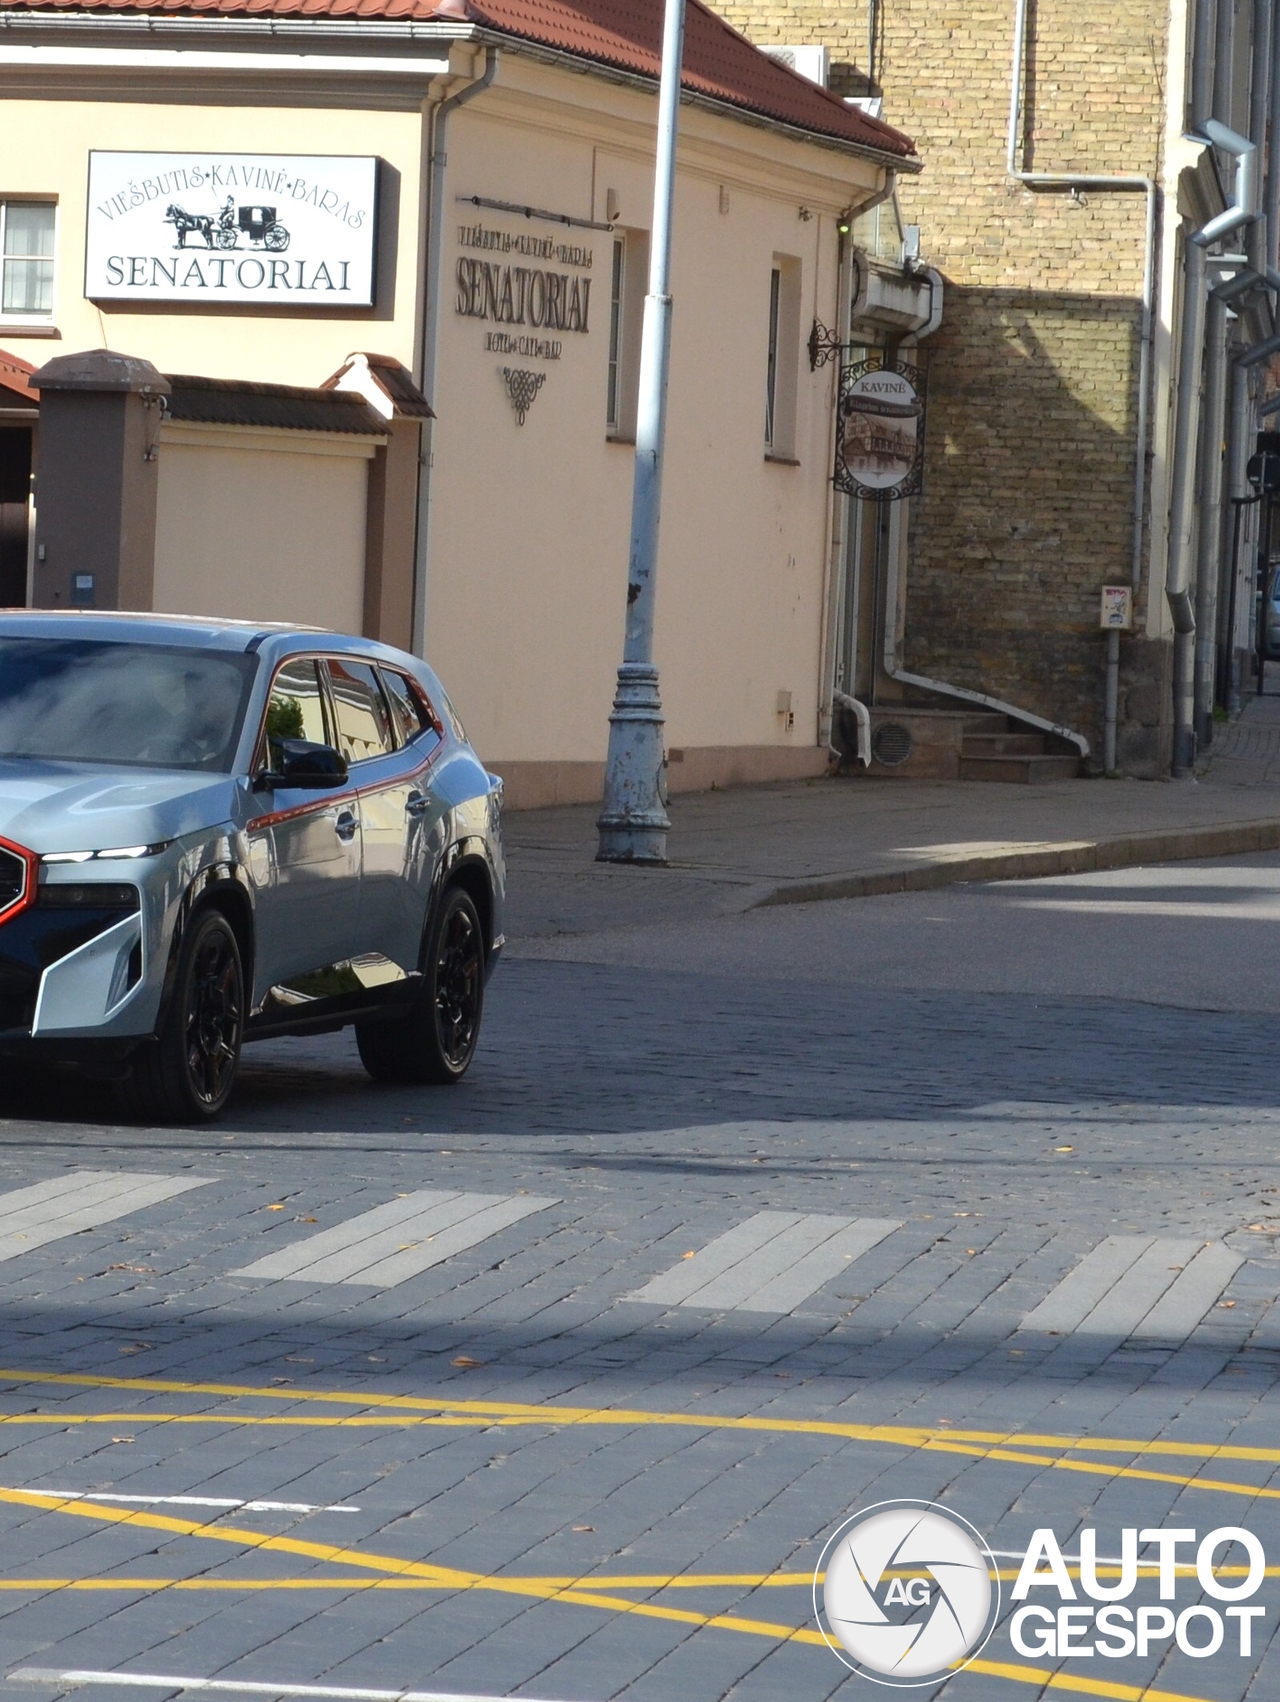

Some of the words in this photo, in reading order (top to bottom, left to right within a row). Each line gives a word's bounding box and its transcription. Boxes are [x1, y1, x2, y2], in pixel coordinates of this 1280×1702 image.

[97, 166, 206, 221] VIEŠBUTIS
[211, 164, 287, 194] KAVINĖ
[292, 178, 366, 229] BARAS
[559, 244, 593, 269] BARAS
[105, 256, 351, 291] SENATORIAI
[456, 256, 592, 333] SENATORIAI
[543, 340, 562, 360] BAR
[861, 381, 906, 394] KAVINĖ
